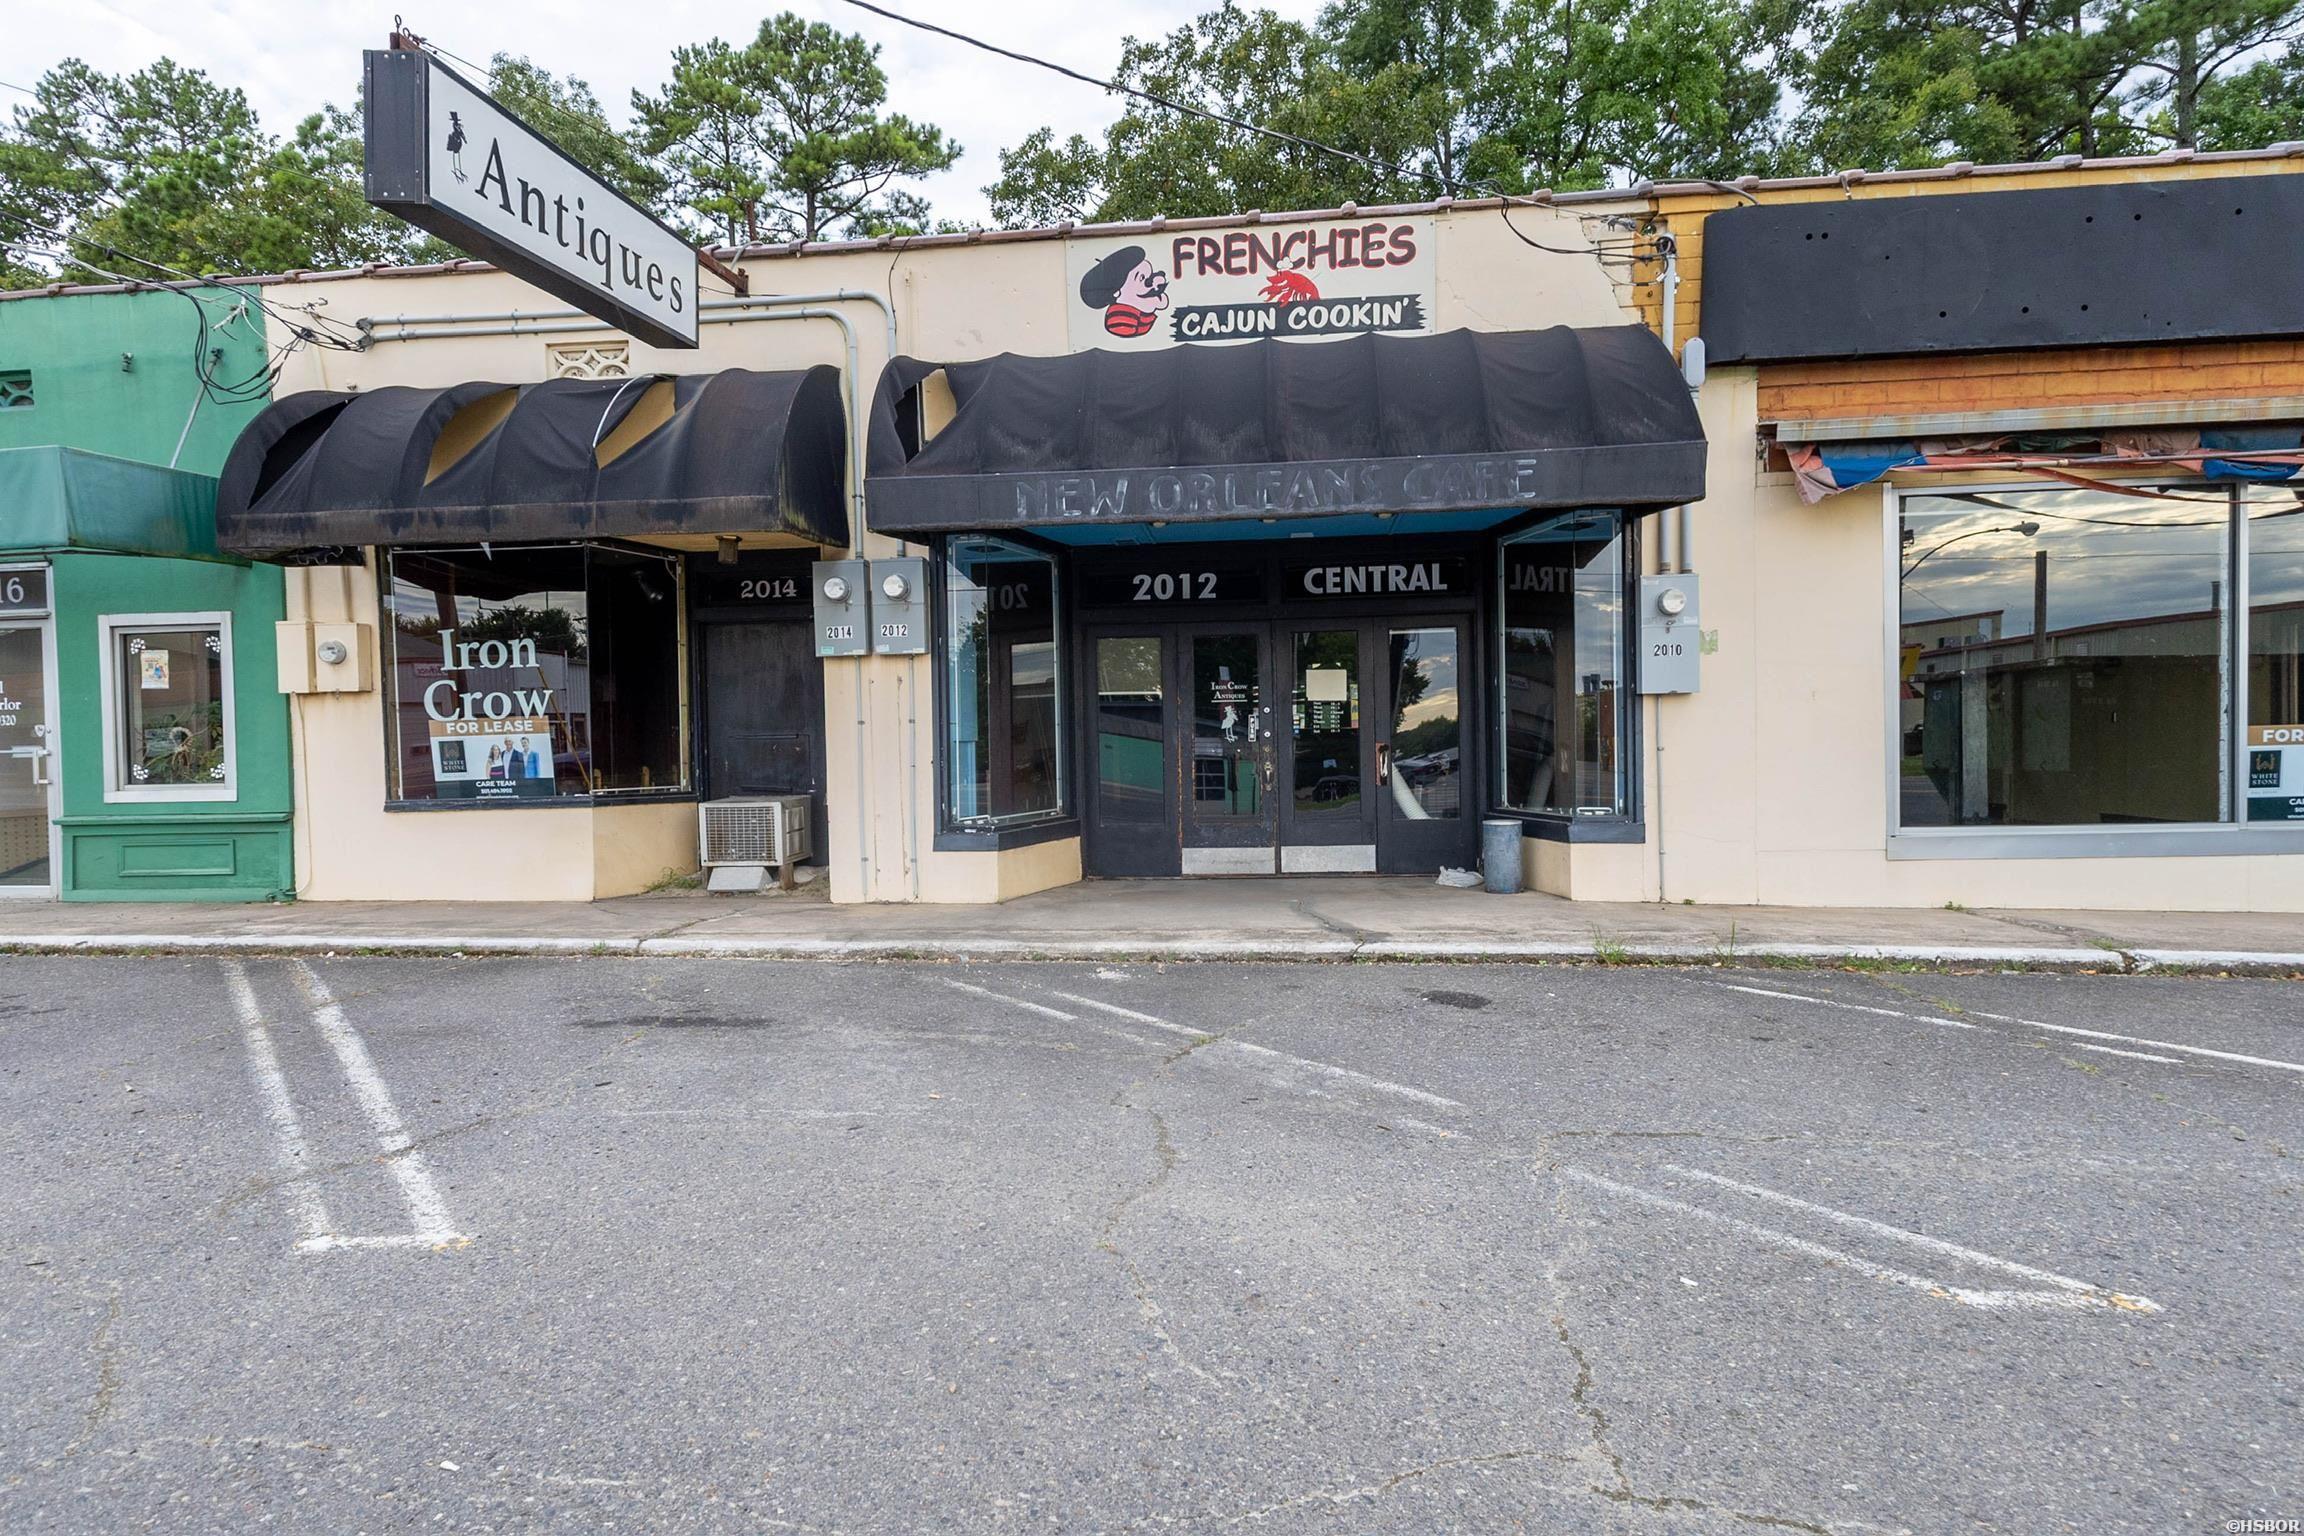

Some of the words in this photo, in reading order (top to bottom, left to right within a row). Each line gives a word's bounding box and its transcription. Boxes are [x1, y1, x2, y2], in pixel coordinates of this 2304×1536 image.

[474, 137, 683, 314] Antiques
[1173, 223, 1416, 279] FRENCHIES
[1181, 307, 1276, 336] CAJUN
[1288, 298, 1409, 328] COOKIN'
[1016, 478, 1128, 518] NEW
[1150, 465, 1383, 514] ORLEANS
[1404, 459, 1537, 500] CAFE
[741, 579, 797, 598] 2014
[1133, 573, 1217, 600] 2012
[1304, 563, 1447, 594] CENTRAL
[827, 626, 852, 638] 2014
[882, 625, 907, 637] 2012
[437, 629, 540, 671] Iron
[1654, 644, 1682, 656] 2010
[423, 680, 553, 721] Crow
[446, 721, 479, 734] FOR
[484, 720, 534, 732] LEASE
[2263, 729, 2304, 742] FOR
